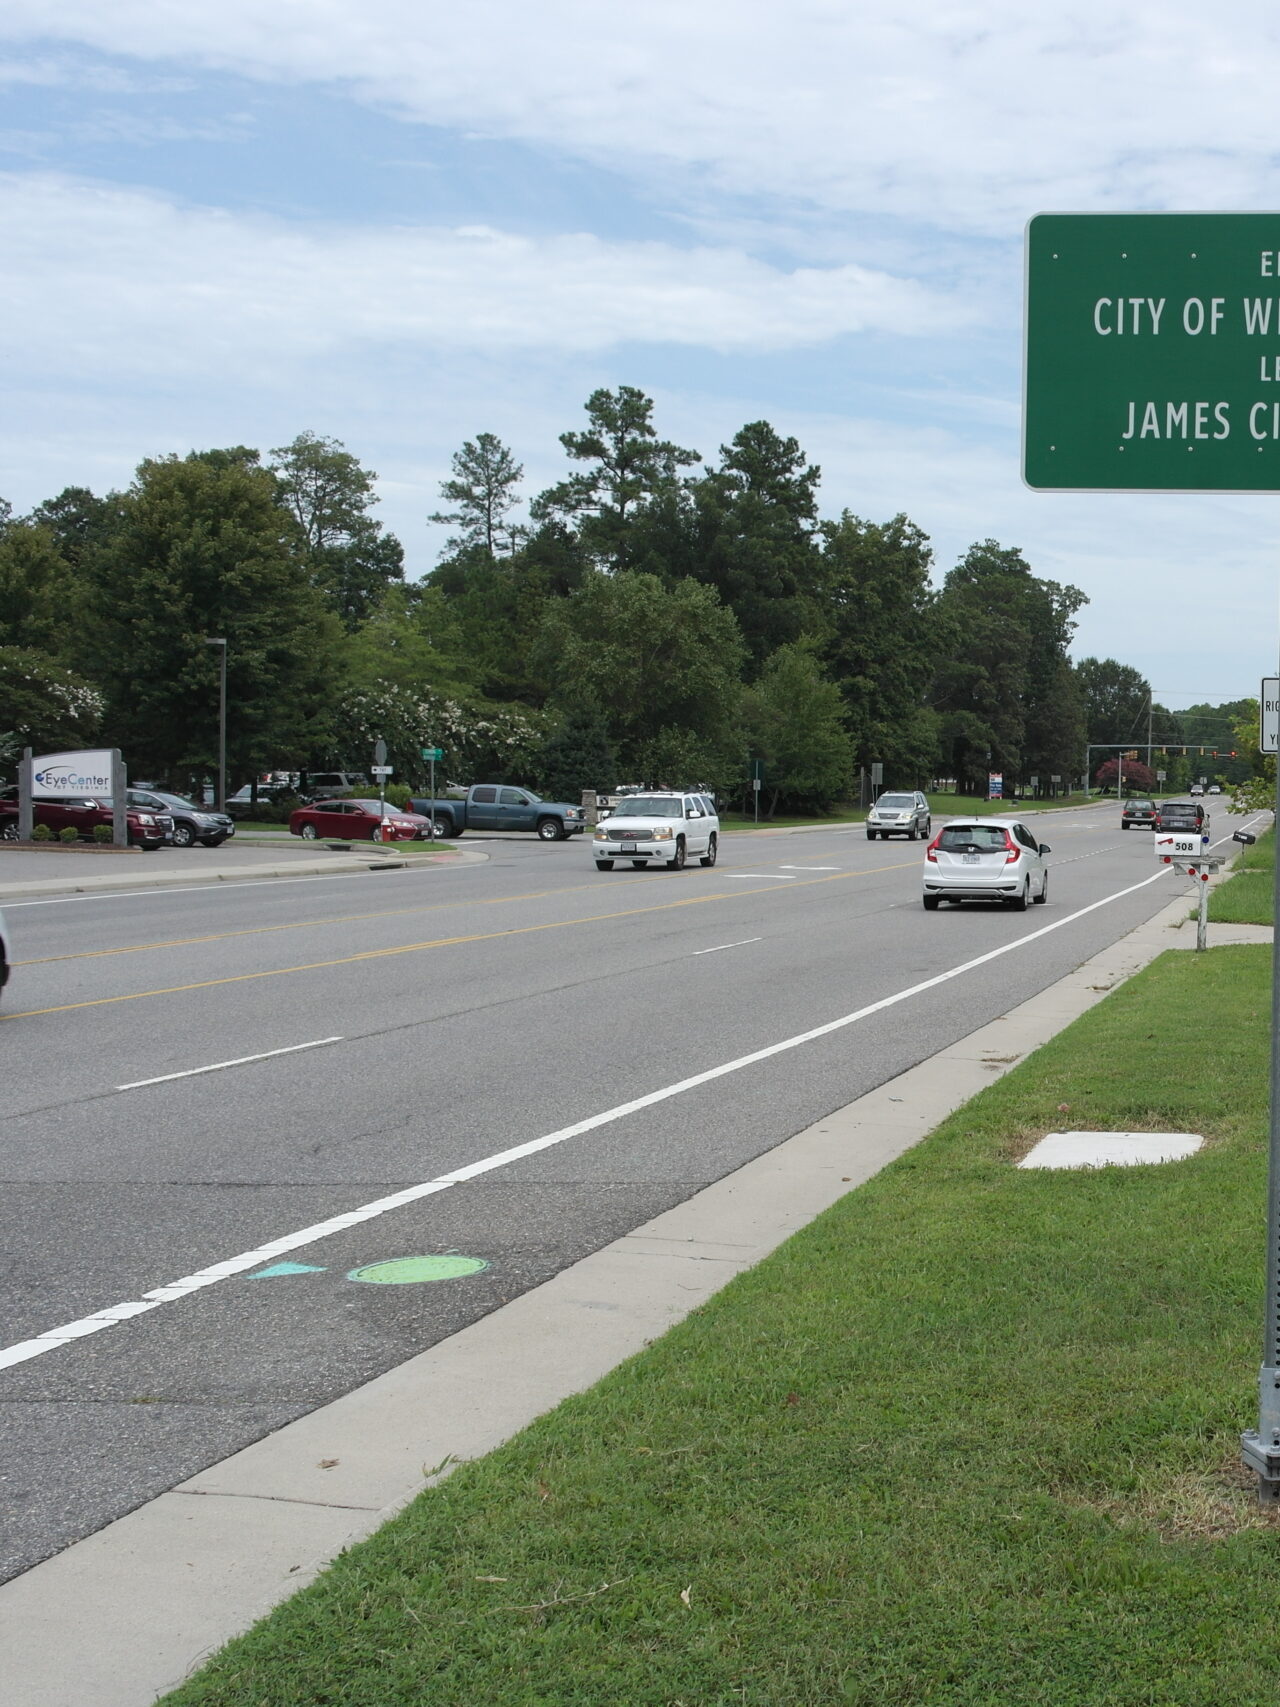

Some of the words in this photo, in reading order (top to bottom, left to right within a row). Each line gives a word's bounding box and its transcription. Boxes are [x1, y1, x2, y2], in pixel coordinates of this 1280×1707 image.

[1094, 297, 1166, 336] CITY
[1183, 297, 1225, 336] OF
[1122, 402, 1230, 439] JAMES
[1265, 700, 1280, 712] RIG
[45, 773, 109, 788] EyeCenter
[1175, 842, 1194, 851] 508
